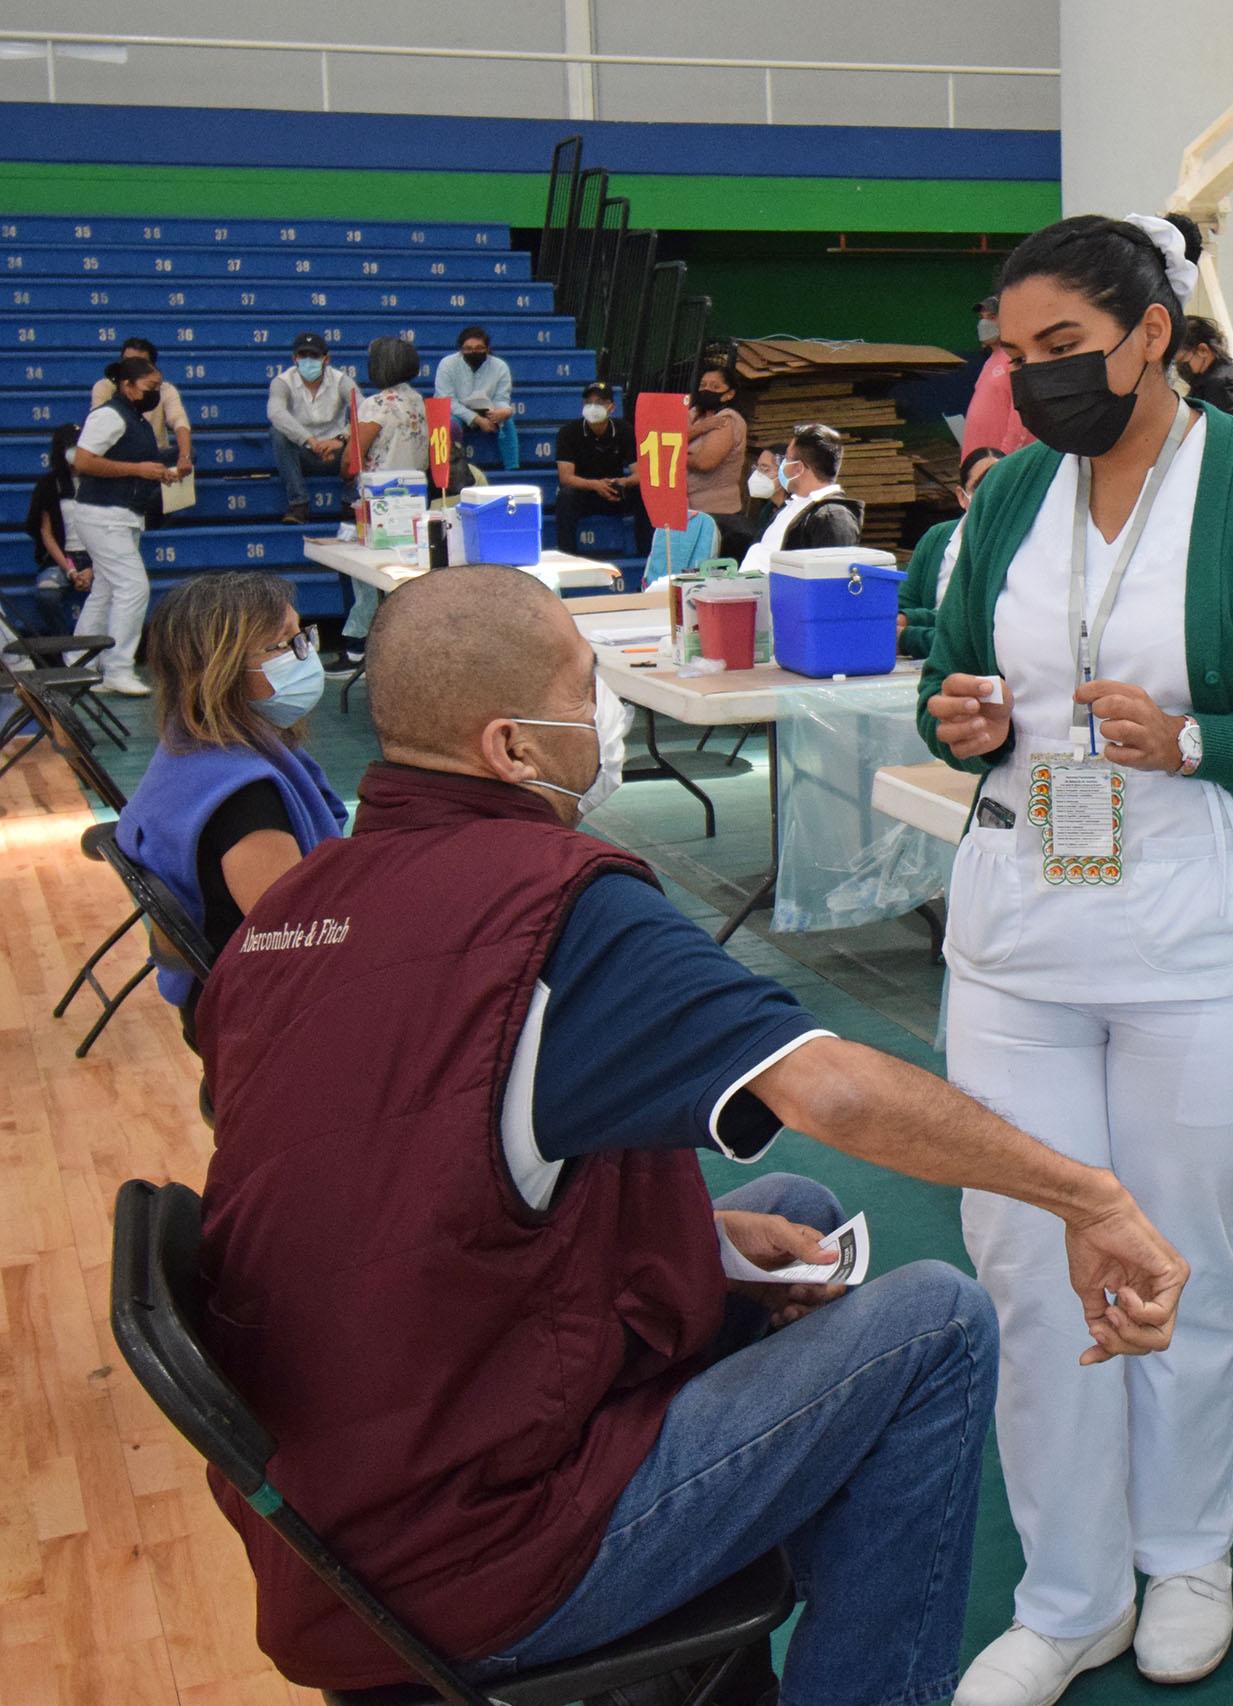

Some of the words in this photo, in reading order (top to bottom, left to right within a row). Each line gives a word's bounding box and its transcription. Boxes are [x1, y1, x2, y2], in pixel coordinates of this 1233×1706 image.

[214, 228, 228, 241] 37
[346, 230, 362, 243] 39
[410, 231, 425, 244] 40
[474, 232, 488, 245] 41
[155, 258, 173, 272] 36
[227, 259, 241, 272] 37
[494, 263, 507, 275] 41
[240, 292, 256, 306] 37
[450, 295, 465, 307] 40
[516, 295, 530, 308] 41
[18, 327, 36, 343] 34
[98, 327, 116, 342] 35
[253, 329, 269, 343] 37
[537, 330, 551, 343] 41
[556, 363, 570, 377] 41
[32, 406, 51, 421] 34
[430, 426, 448, 465] 18
[535, 441, 552, 458] 40
[640, 431, 682, 489] 17
[314, 492, 333, 508] 37
[579, 531, 596, 545] 40
[155, 546, 177, 563] 35
[246, 543, 265, 559] 36
[304, 920, 318, 947] &
[317, 916, 351, 945] Fitch
